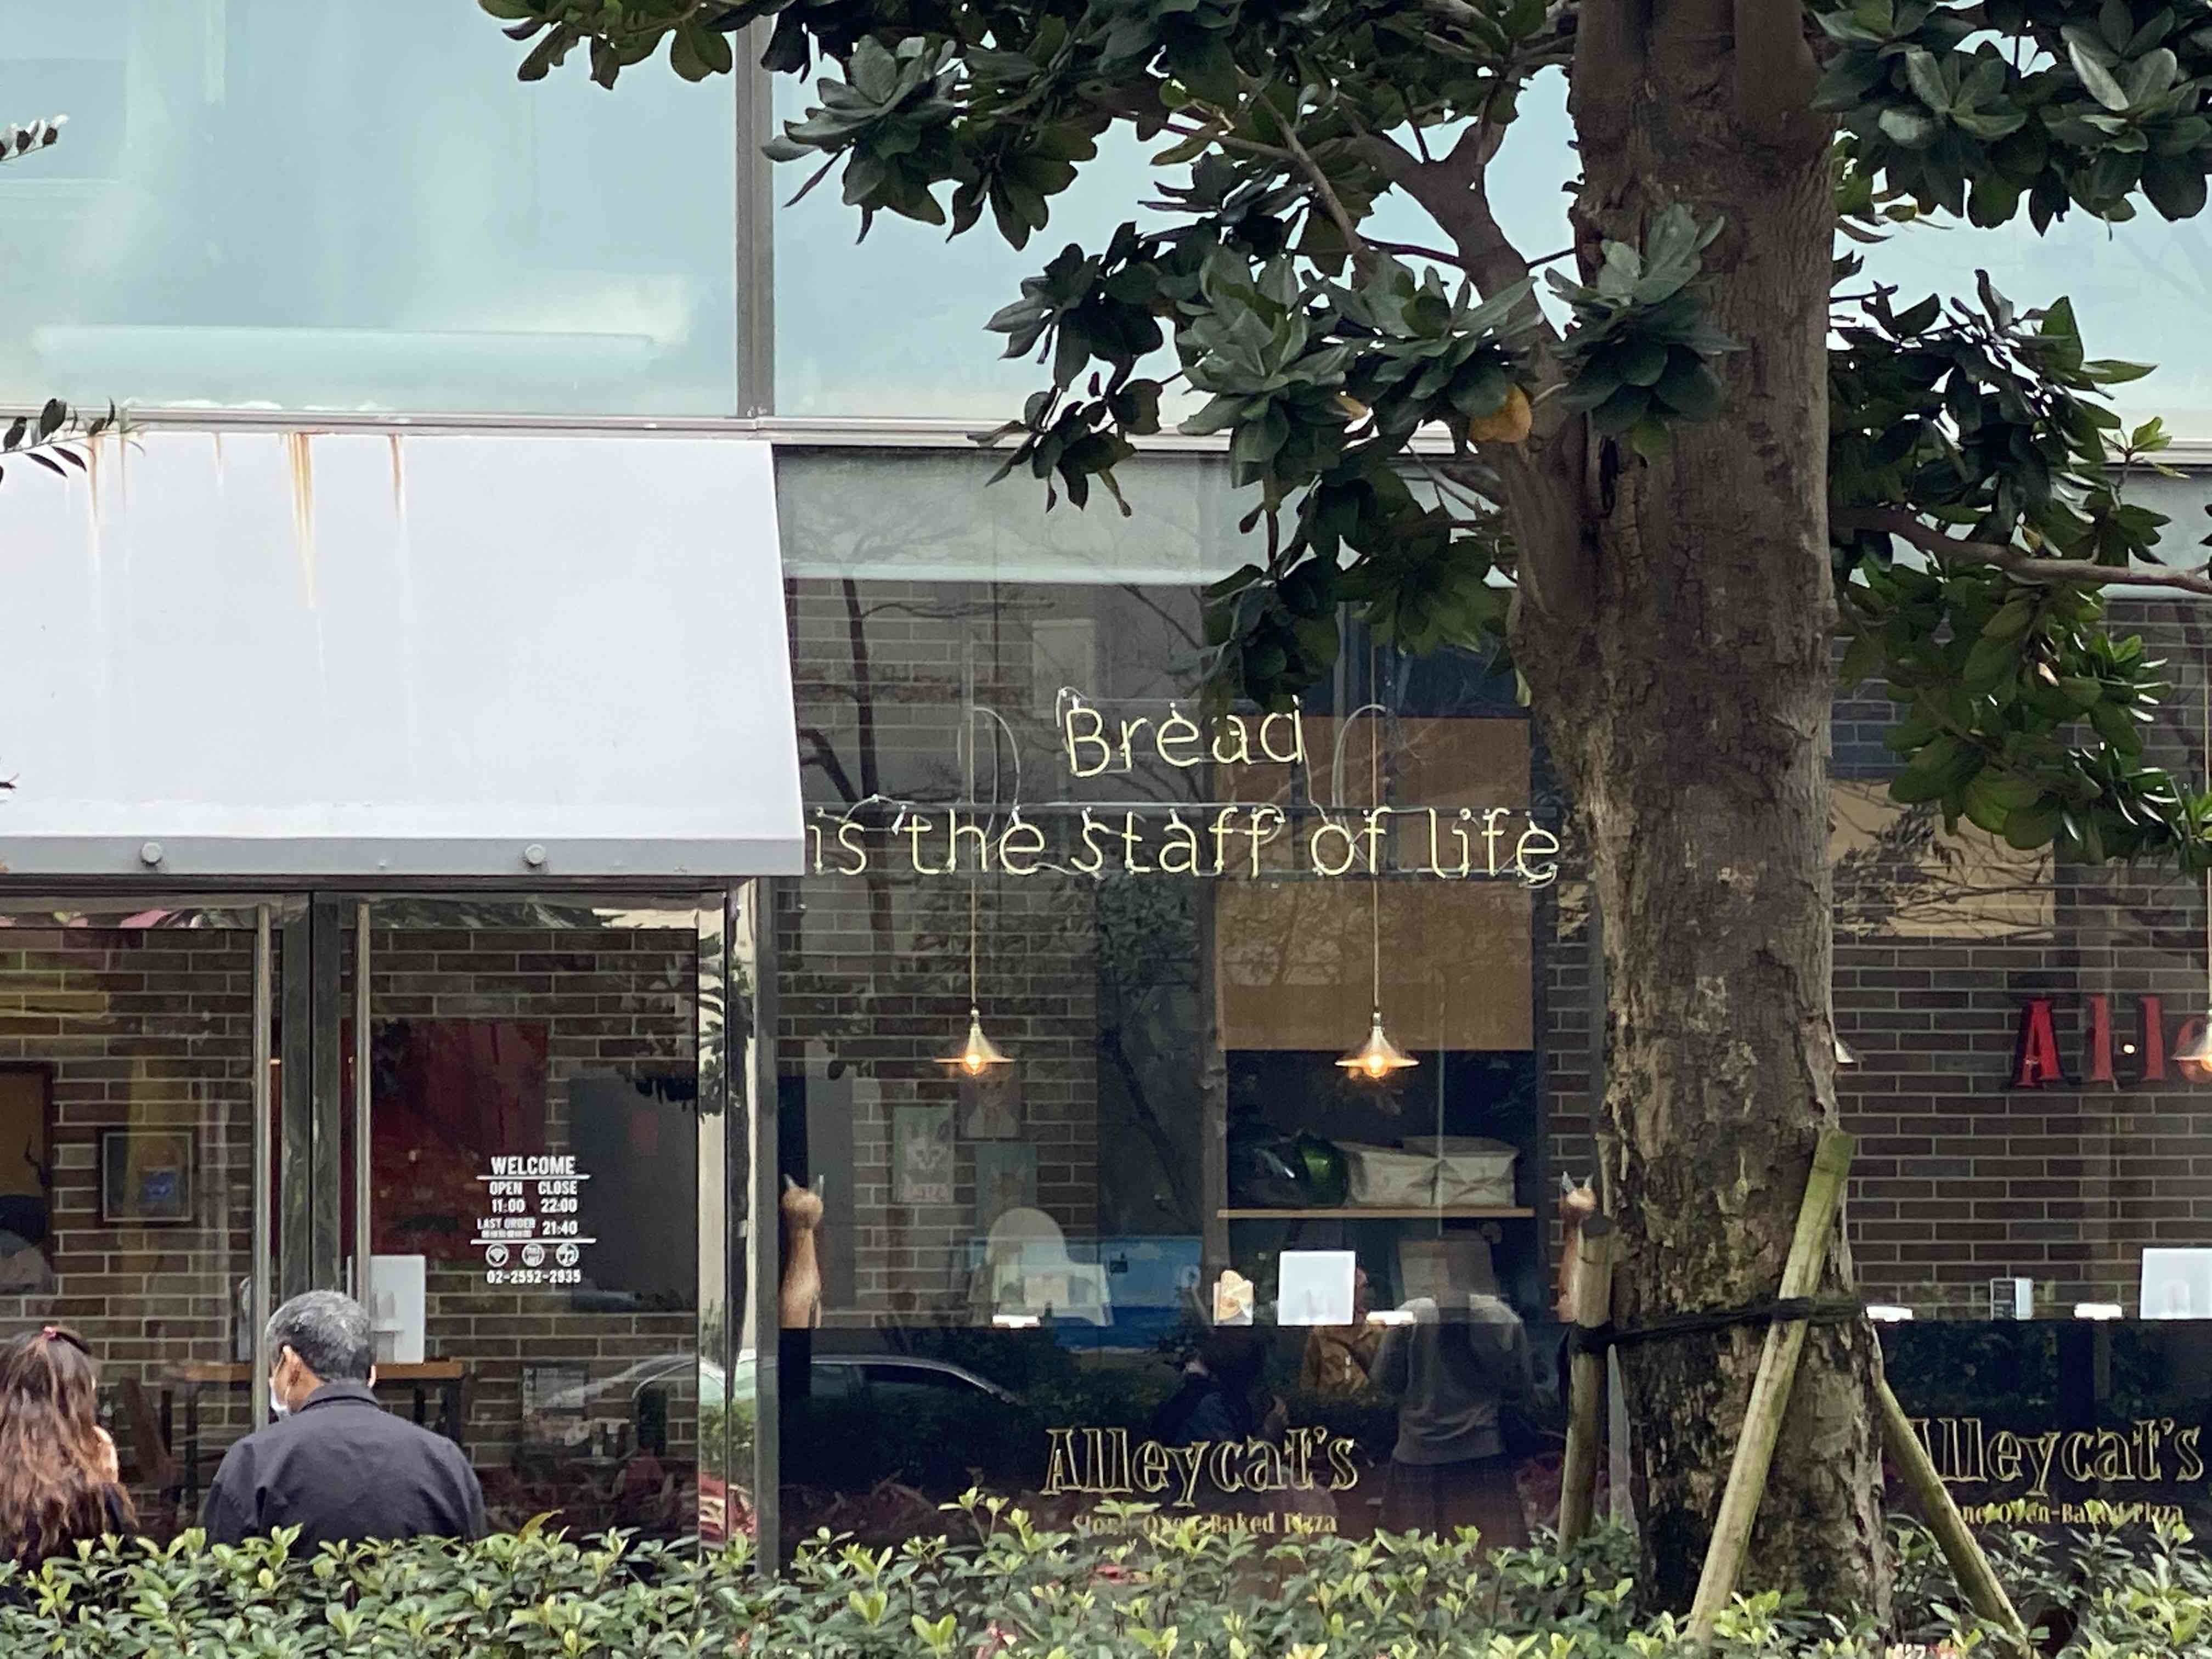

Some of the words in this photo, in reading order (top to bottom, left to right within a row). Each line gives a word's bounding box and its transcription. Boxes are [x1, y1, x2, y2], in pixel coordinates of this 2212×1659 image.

[1066, 707, 1304, 778] Bread
[806, 811, 867, 876] is
[902, 808, 1045, 875] the
[1070, 807, 1278, 878] staff
[1310, 806, 1392, 876] of
[1428, 807, 1560, 879] life
[490, 1156, 575, 1175] WELCOME
[489, 1181, 523, 1195] OPEN
[538, 1180, 578, 1195] CLOSE
[492, 1198, 526, 1213] 11:00
[540, 1198, 578, 1214] 22:00
[477, 1217, 501, 1230] LAST
[542, 1220, 578, 1235] 21:40
[1039, 1426, 1358, 1508] Alleycat's
